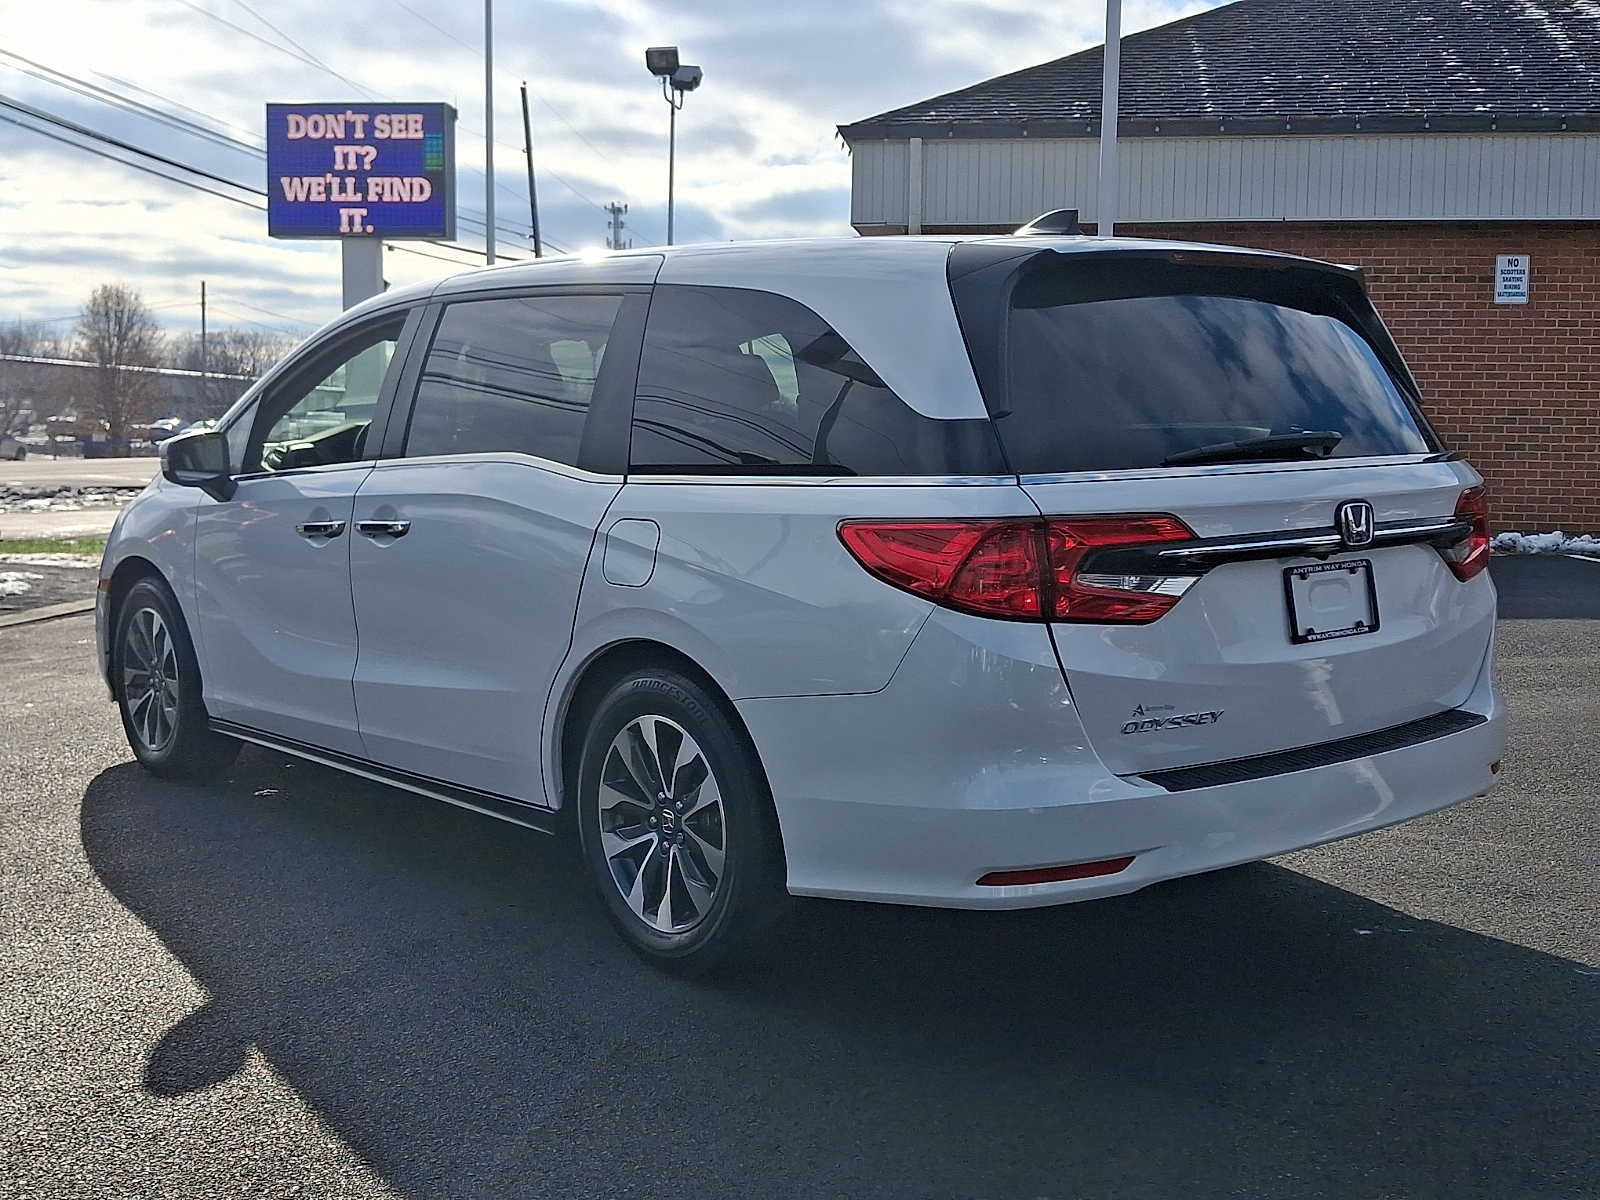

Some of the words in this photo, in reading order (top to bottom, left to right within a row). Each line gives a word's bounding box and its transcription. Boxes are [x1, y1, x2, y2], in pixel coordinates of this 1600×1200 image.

[286, 110, 370, 140] DON'T
[373, 114, 425, 140] SEE
[333, 145, 378, 171] IT?
[280, 173, 363, 202] WE'LL
[366, 176, 432, 202] FIND
[339, 208, 375, 233] IT.
[1507, 258, 1519, 268] NO
[1293, 565, 1322, 575] ANTRIM
[1323, 563, 1340, 571] WAY
[1341, 560, 1367, 569] HONDA
[1120, 709, 1225, 735] ODYSSEY
